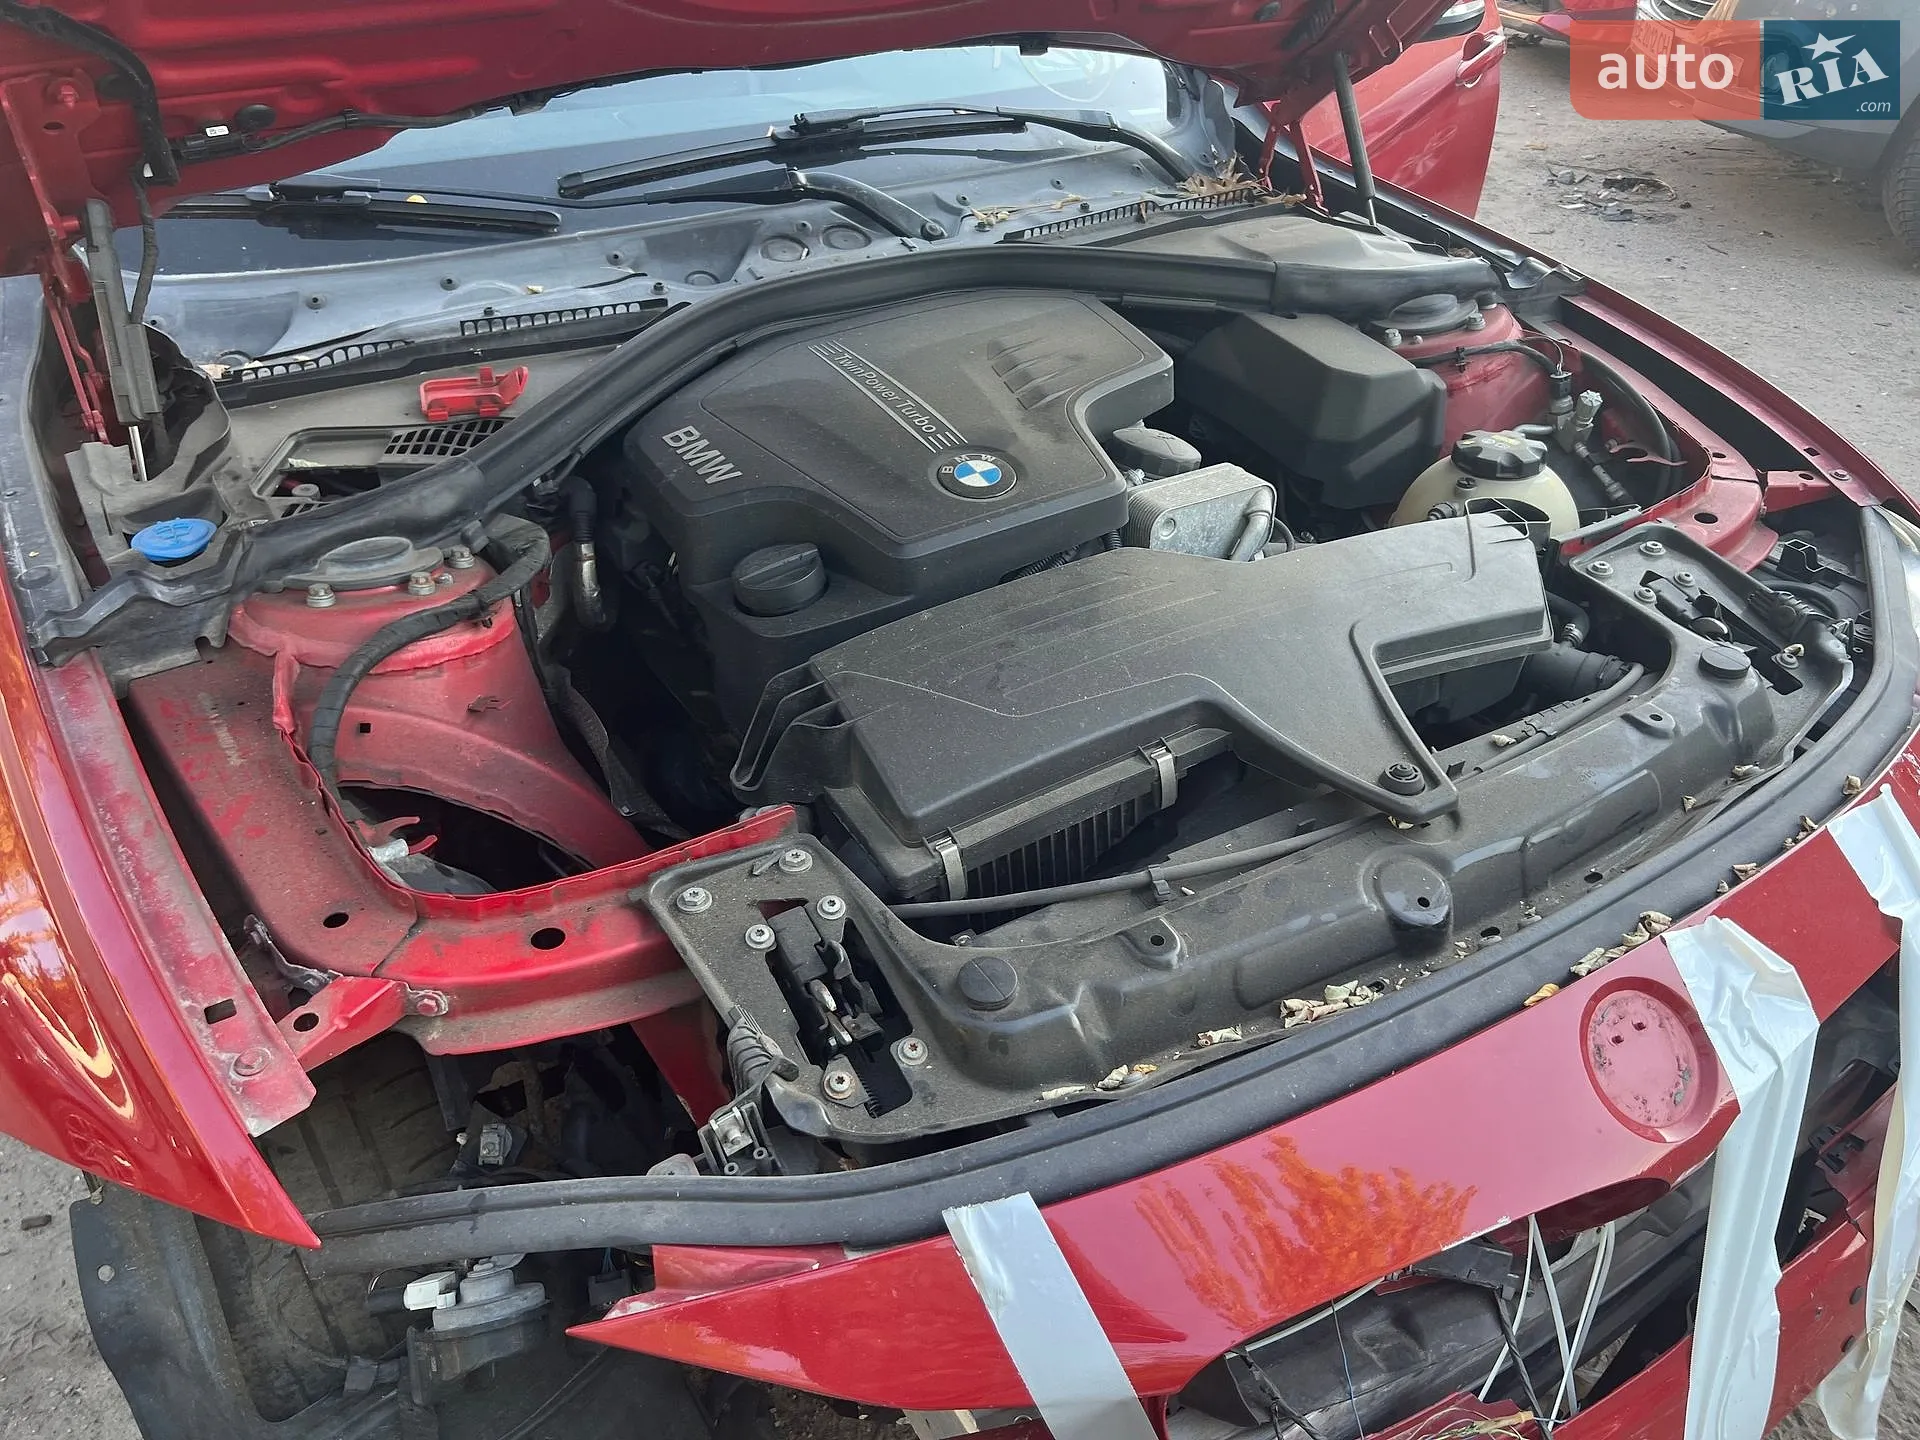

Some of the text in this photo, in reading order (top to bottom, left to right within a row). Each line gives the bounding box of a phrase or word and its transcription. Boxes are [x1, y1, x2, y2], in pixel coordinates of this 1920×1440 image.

[834, 353, 936, 434] TwinPower Turbo
[662, 425, 743, 484] BMW
[942, 453, 996, 474] BMW
